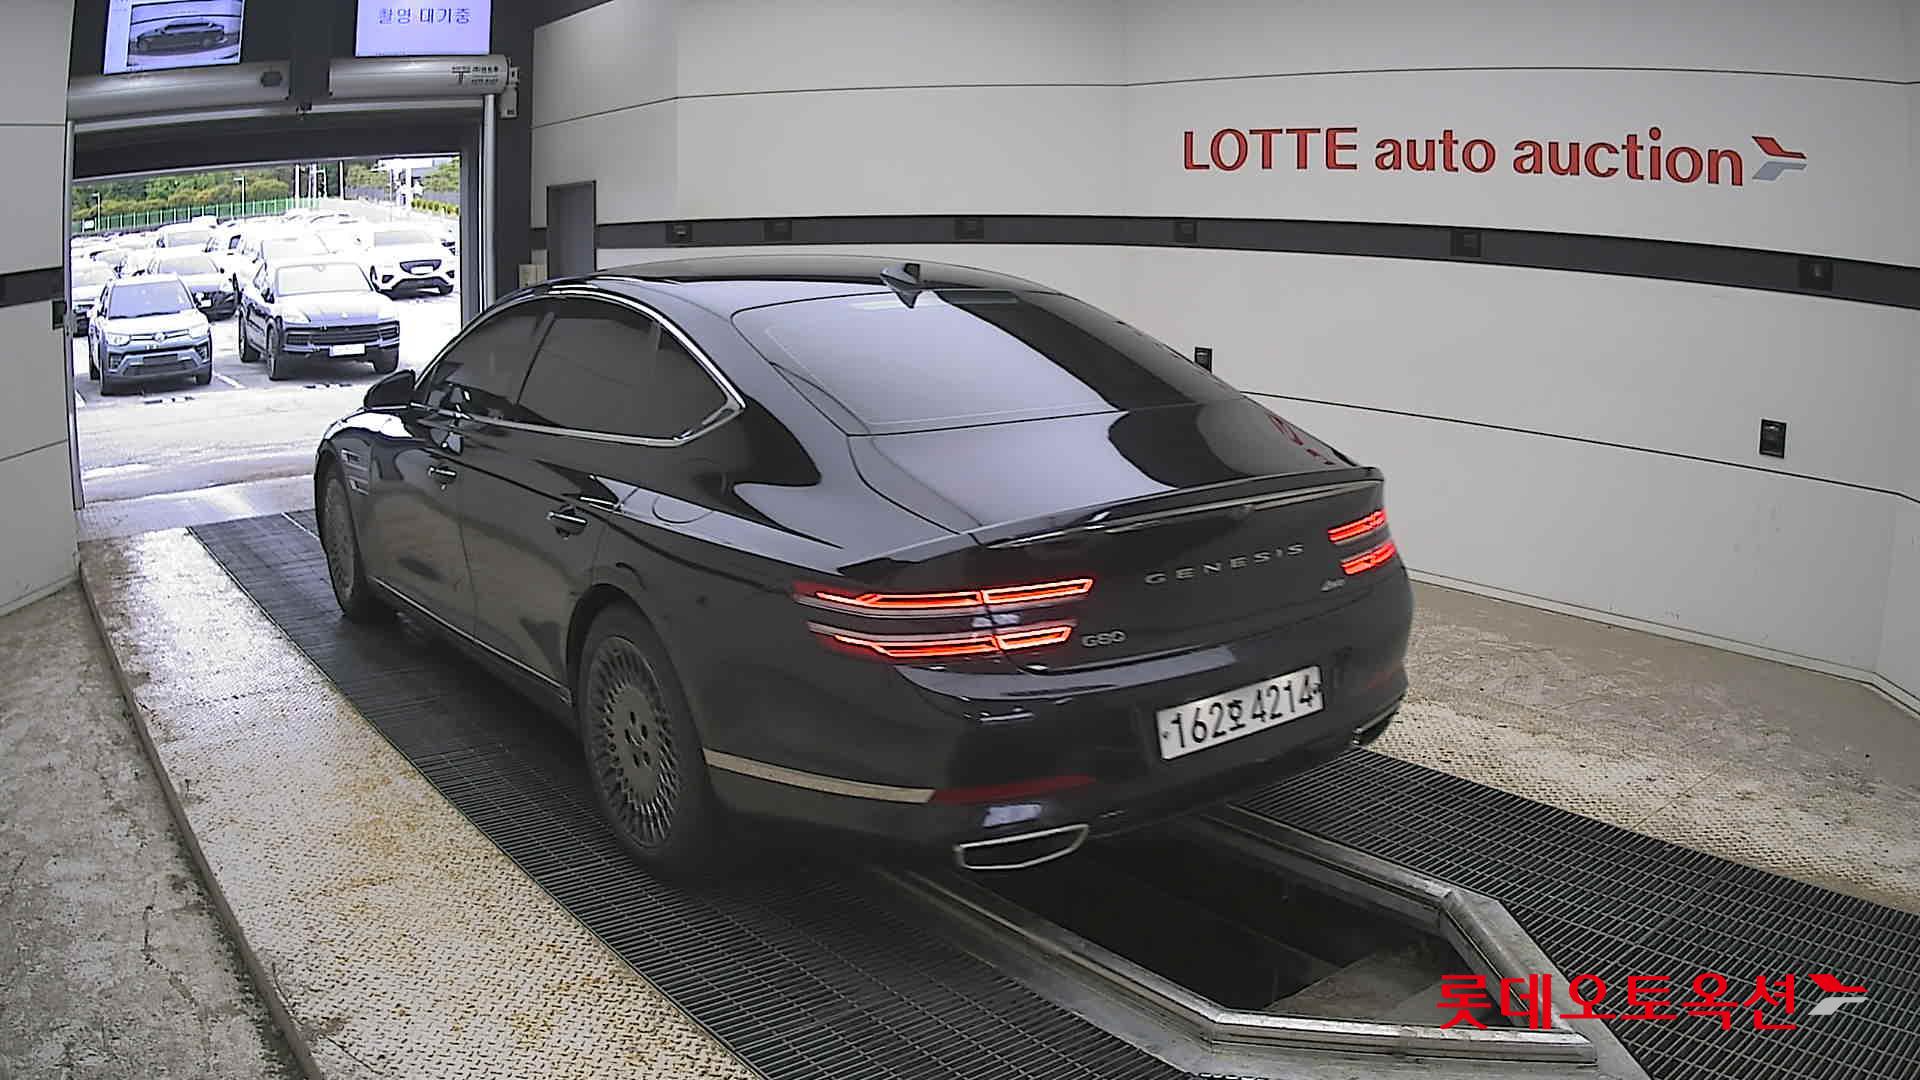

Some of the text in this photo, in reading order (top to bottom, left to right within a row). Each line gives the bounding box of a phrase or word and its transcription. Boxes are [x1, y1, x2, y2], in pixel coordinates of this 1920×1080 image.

[419, 8, 470, 24] 대기중
[1184, 126, 1744, 186] LOTTE auto auction
[1145, 544, 1304, 584] GENESIS
